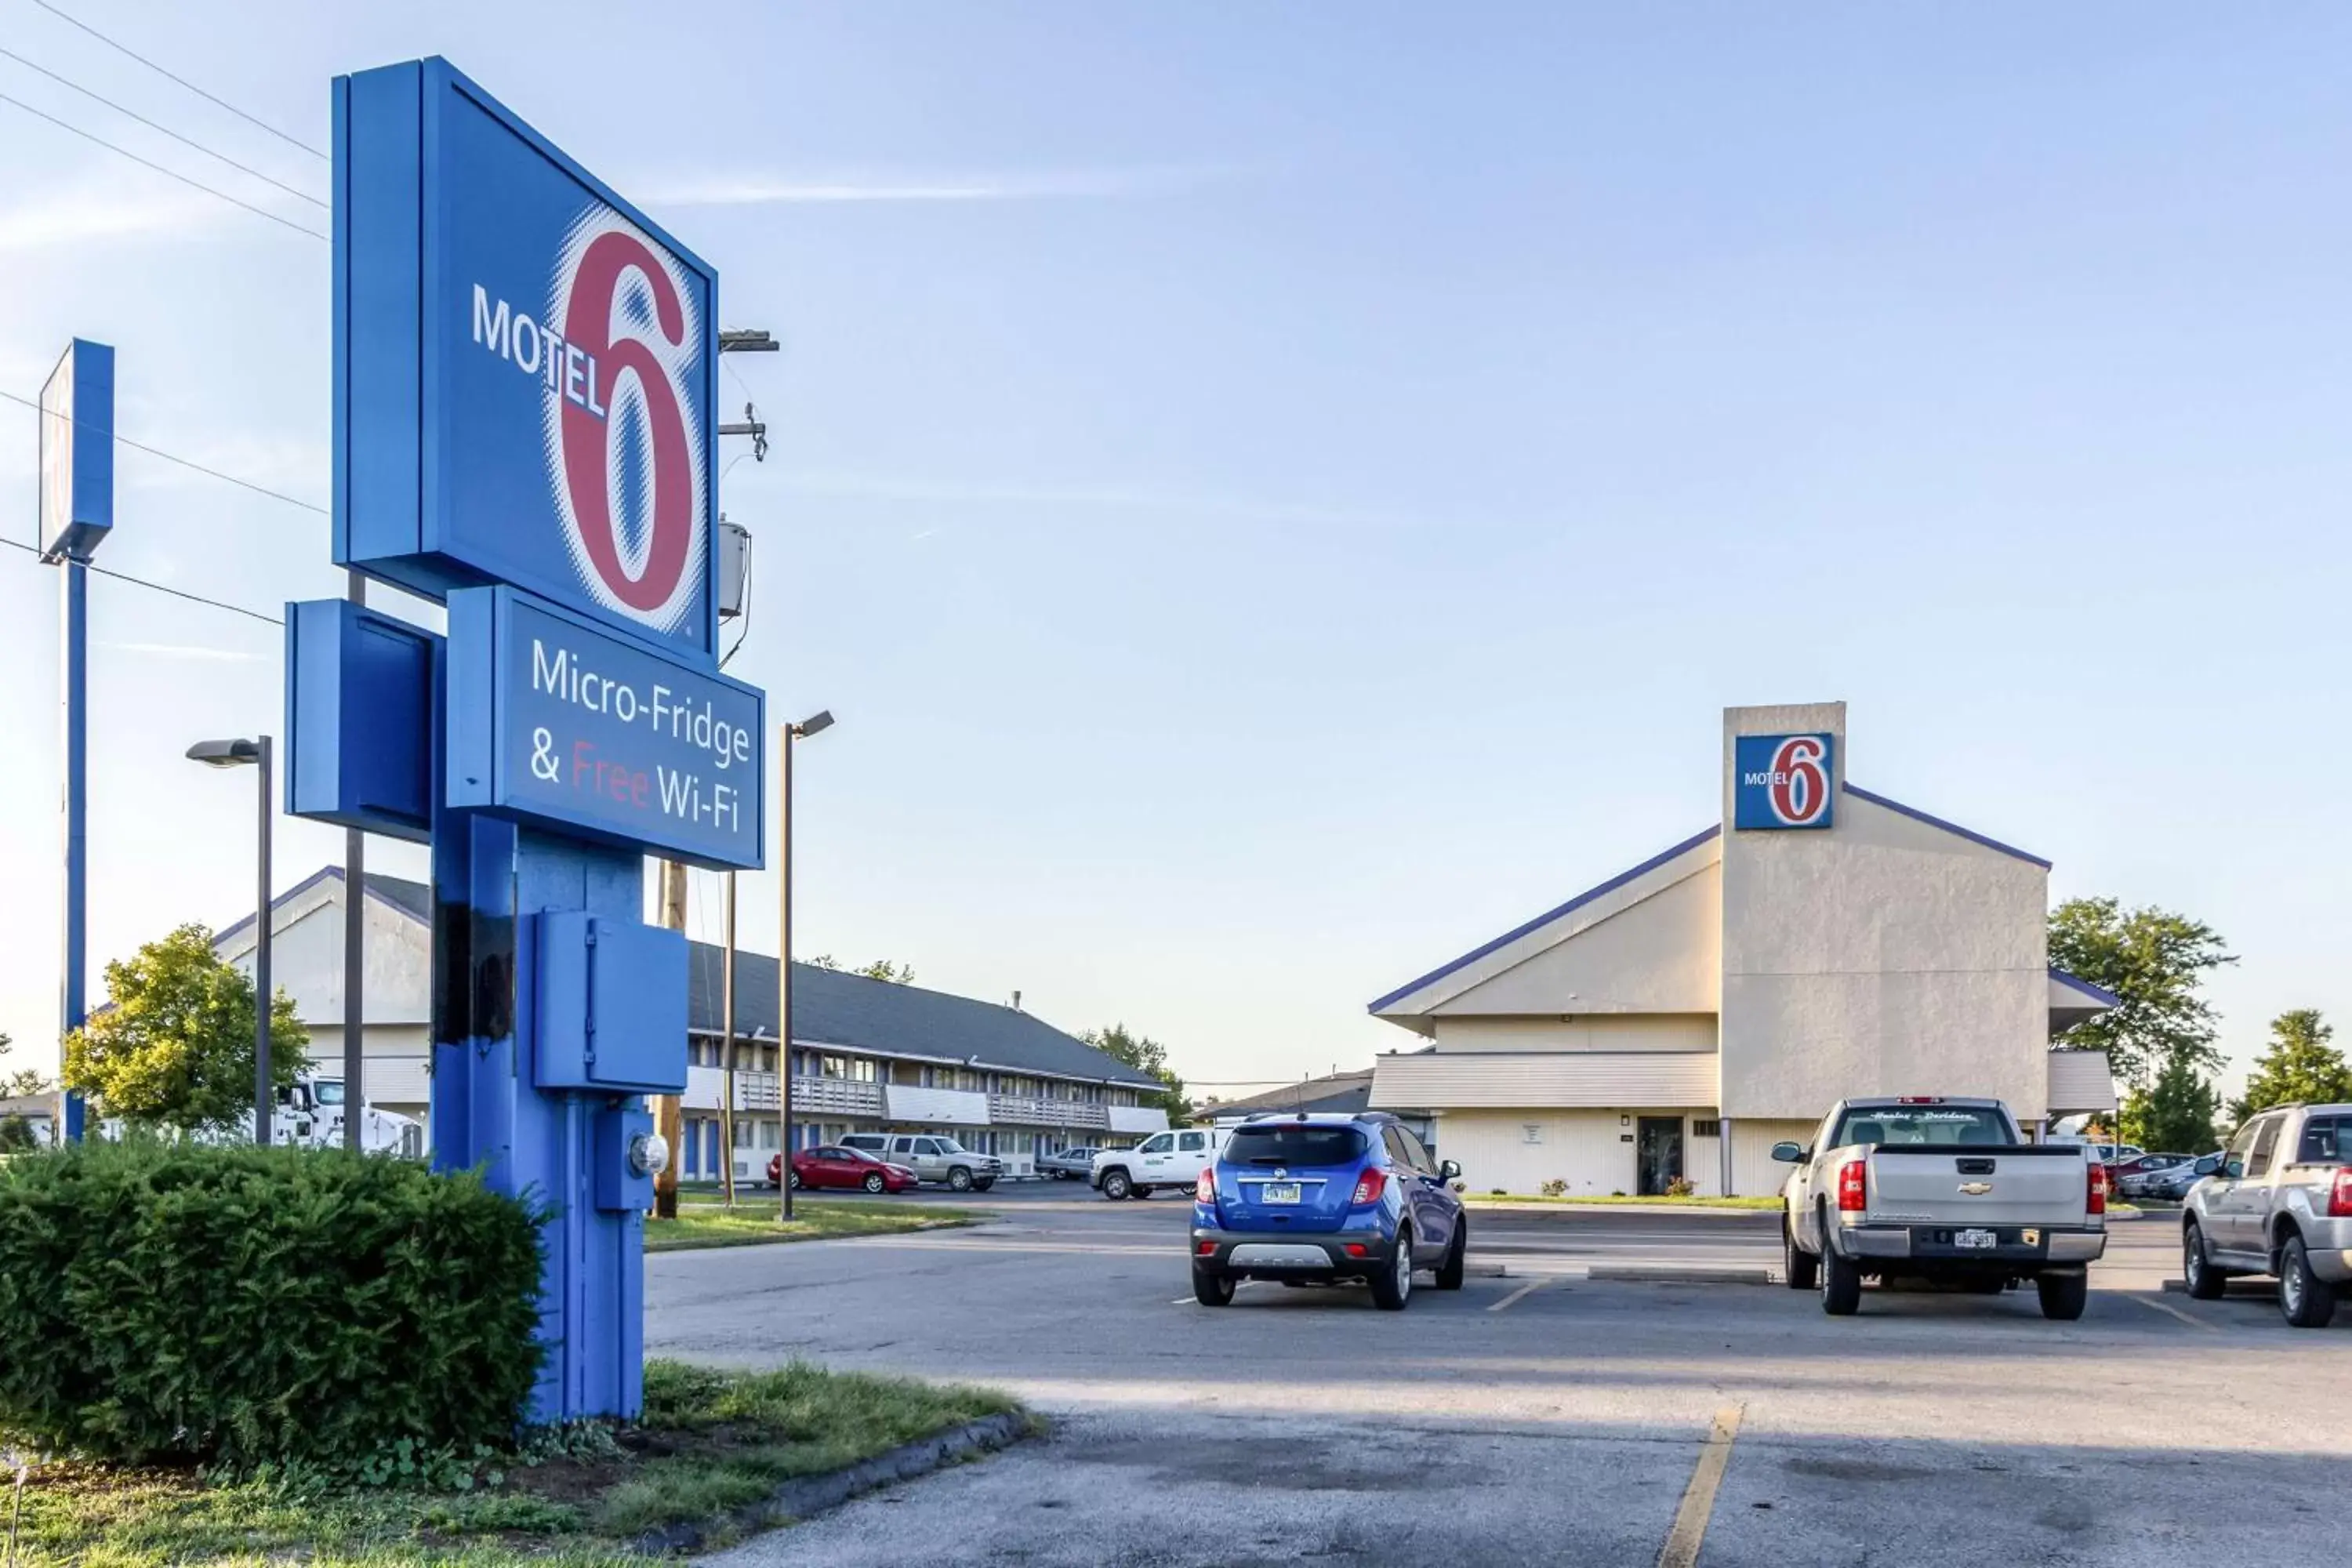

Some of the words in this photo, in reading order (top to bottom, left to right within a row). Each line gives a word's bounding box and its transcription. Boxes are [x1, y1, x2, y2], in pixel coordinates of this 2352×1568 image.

[474, 283, 604, 417] MOTEL
[561, 231, 692, 612] 6
[532, 639, 750, 768] Micro-Fridge
[531, 727, 560, 782] &
[572, 740, 650, 808] Free
[657, 765, 738, 833] Wi-Fi
[1744, 772, 1788, 785] MOTEL
[1773, 739, 1824, 822] 6
